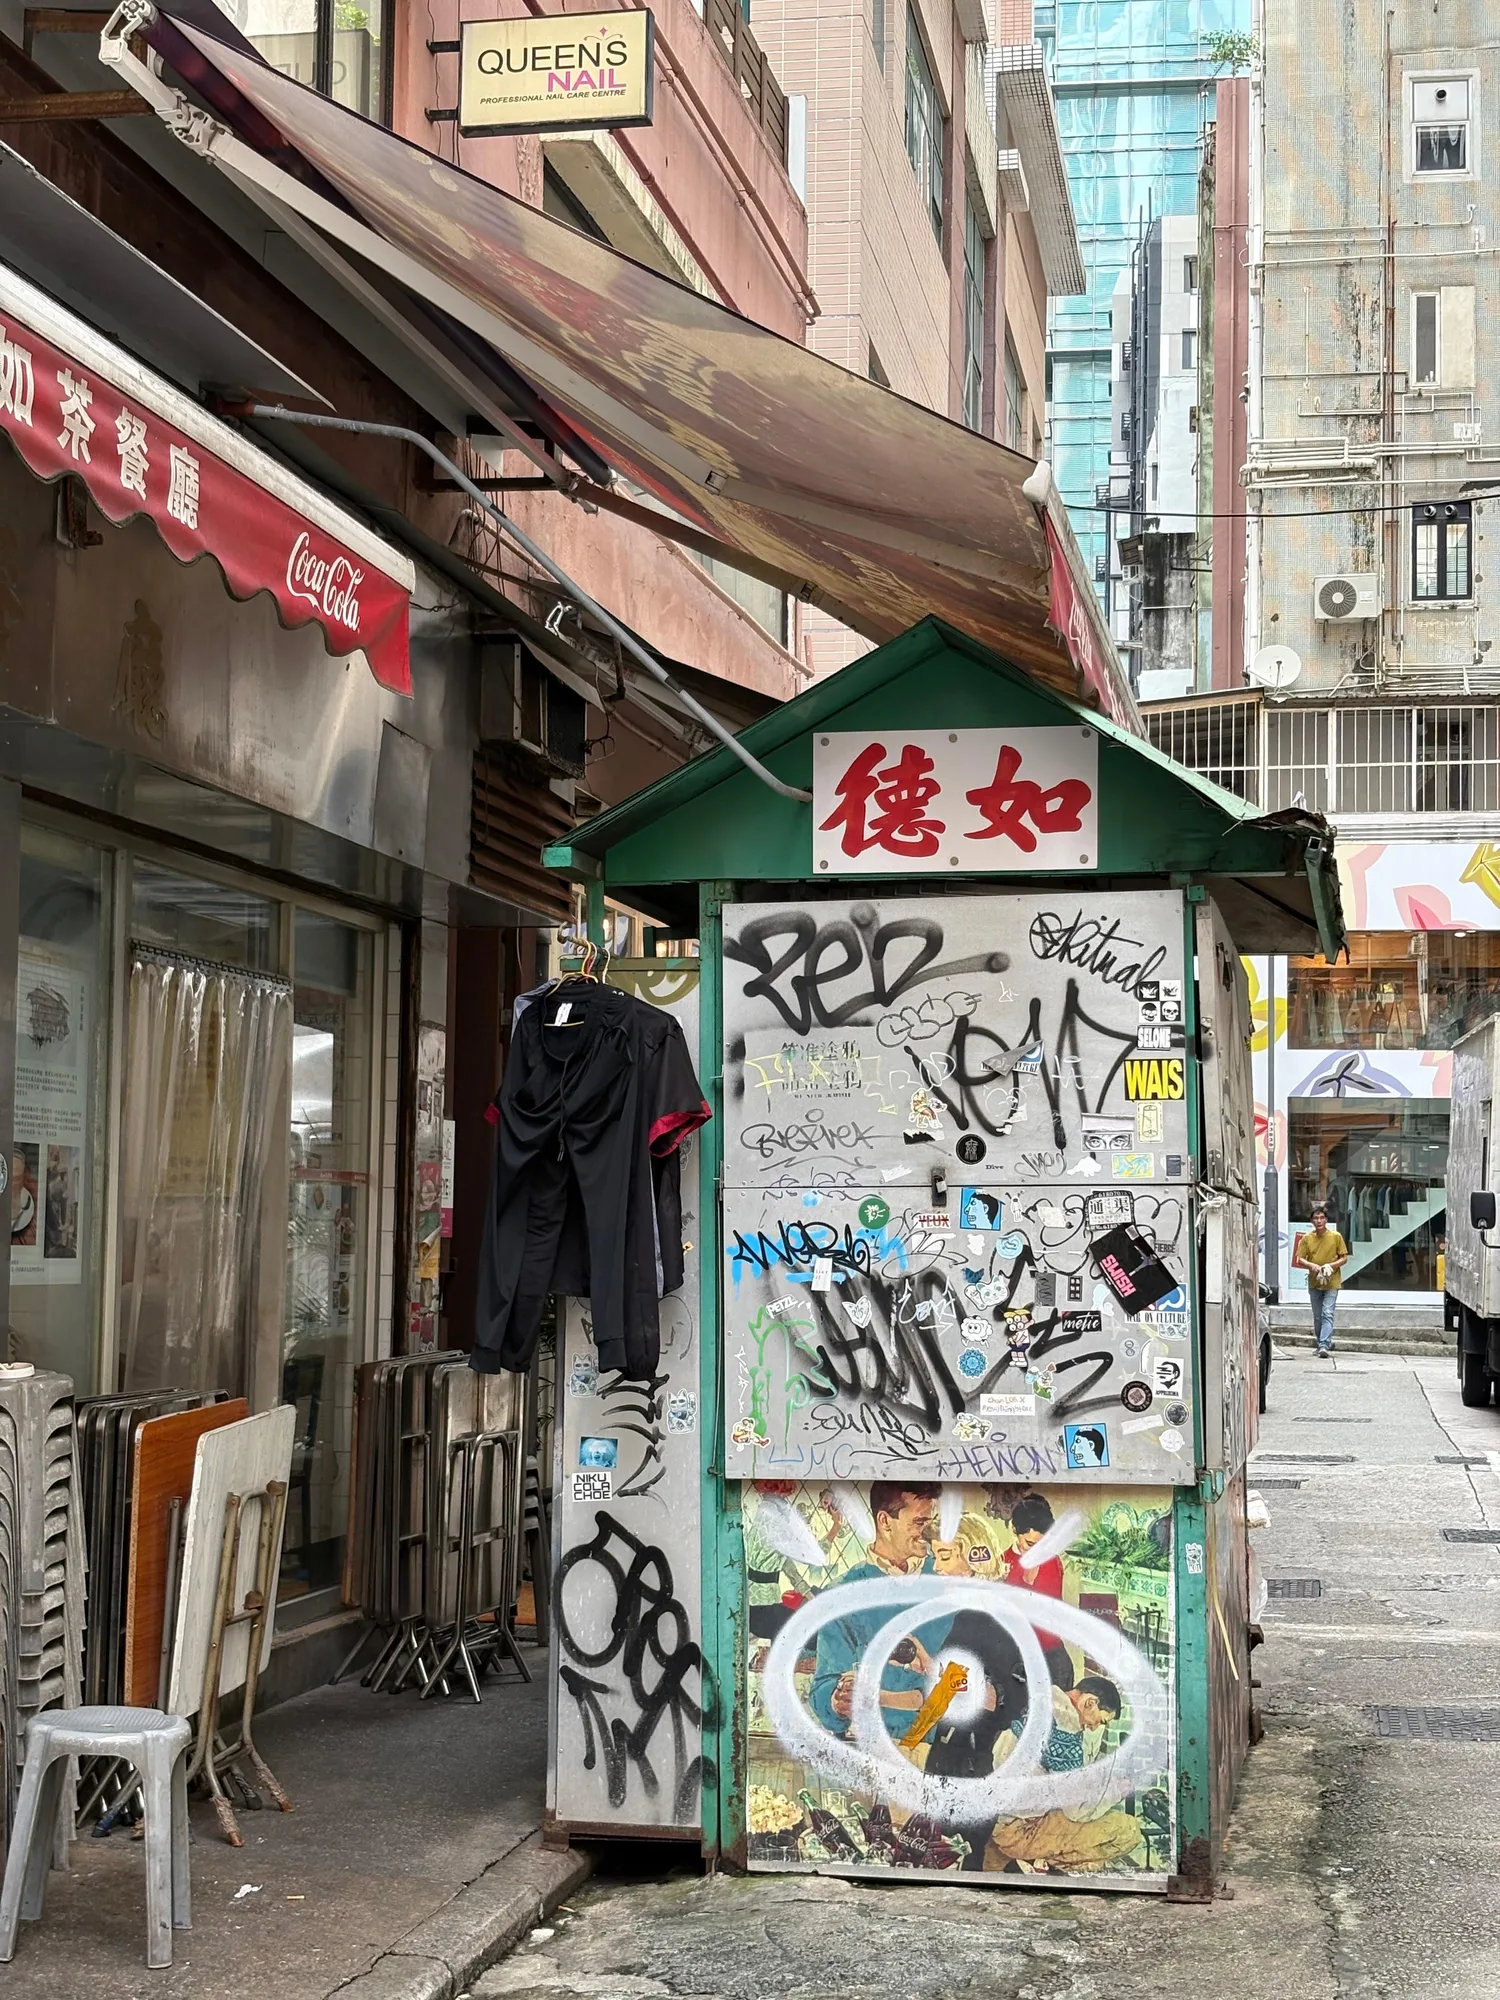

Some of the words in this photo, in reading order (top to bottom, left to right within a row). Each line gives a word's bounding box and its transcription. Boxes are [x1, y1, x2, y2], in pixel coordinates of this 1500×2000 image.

[548, 68, 627, 92] NAIL
[480, 95, 544, 105] PROFESSIONAL
[566, 91, 590, 99] CARE
[591, 89, 626, 98] CENTRE
[286, 531, 366, 632] Coca-Cola
[818, 742, 1092, 859] 德如
[1137, 1027, 1172, 1049] SELONE
[1125, 1059, 1184, 1100] WAIS
[1101, 1254, 1137, 1298] SWISH
[1144, 1313, 1154, 1323] ON
[1156, 1312, 1187, 1324] CULTURE
[573, 1482, 610, 1492] COLA
[576, 1473, 607, 1483] NIKU
[573, 1490, 611, 1501] CHOE
[970, 1547, 988, 1559] OK
[950, 1678, 968, 1690] UFO
[898, 1831, 929, 1851] Coca-Cola
